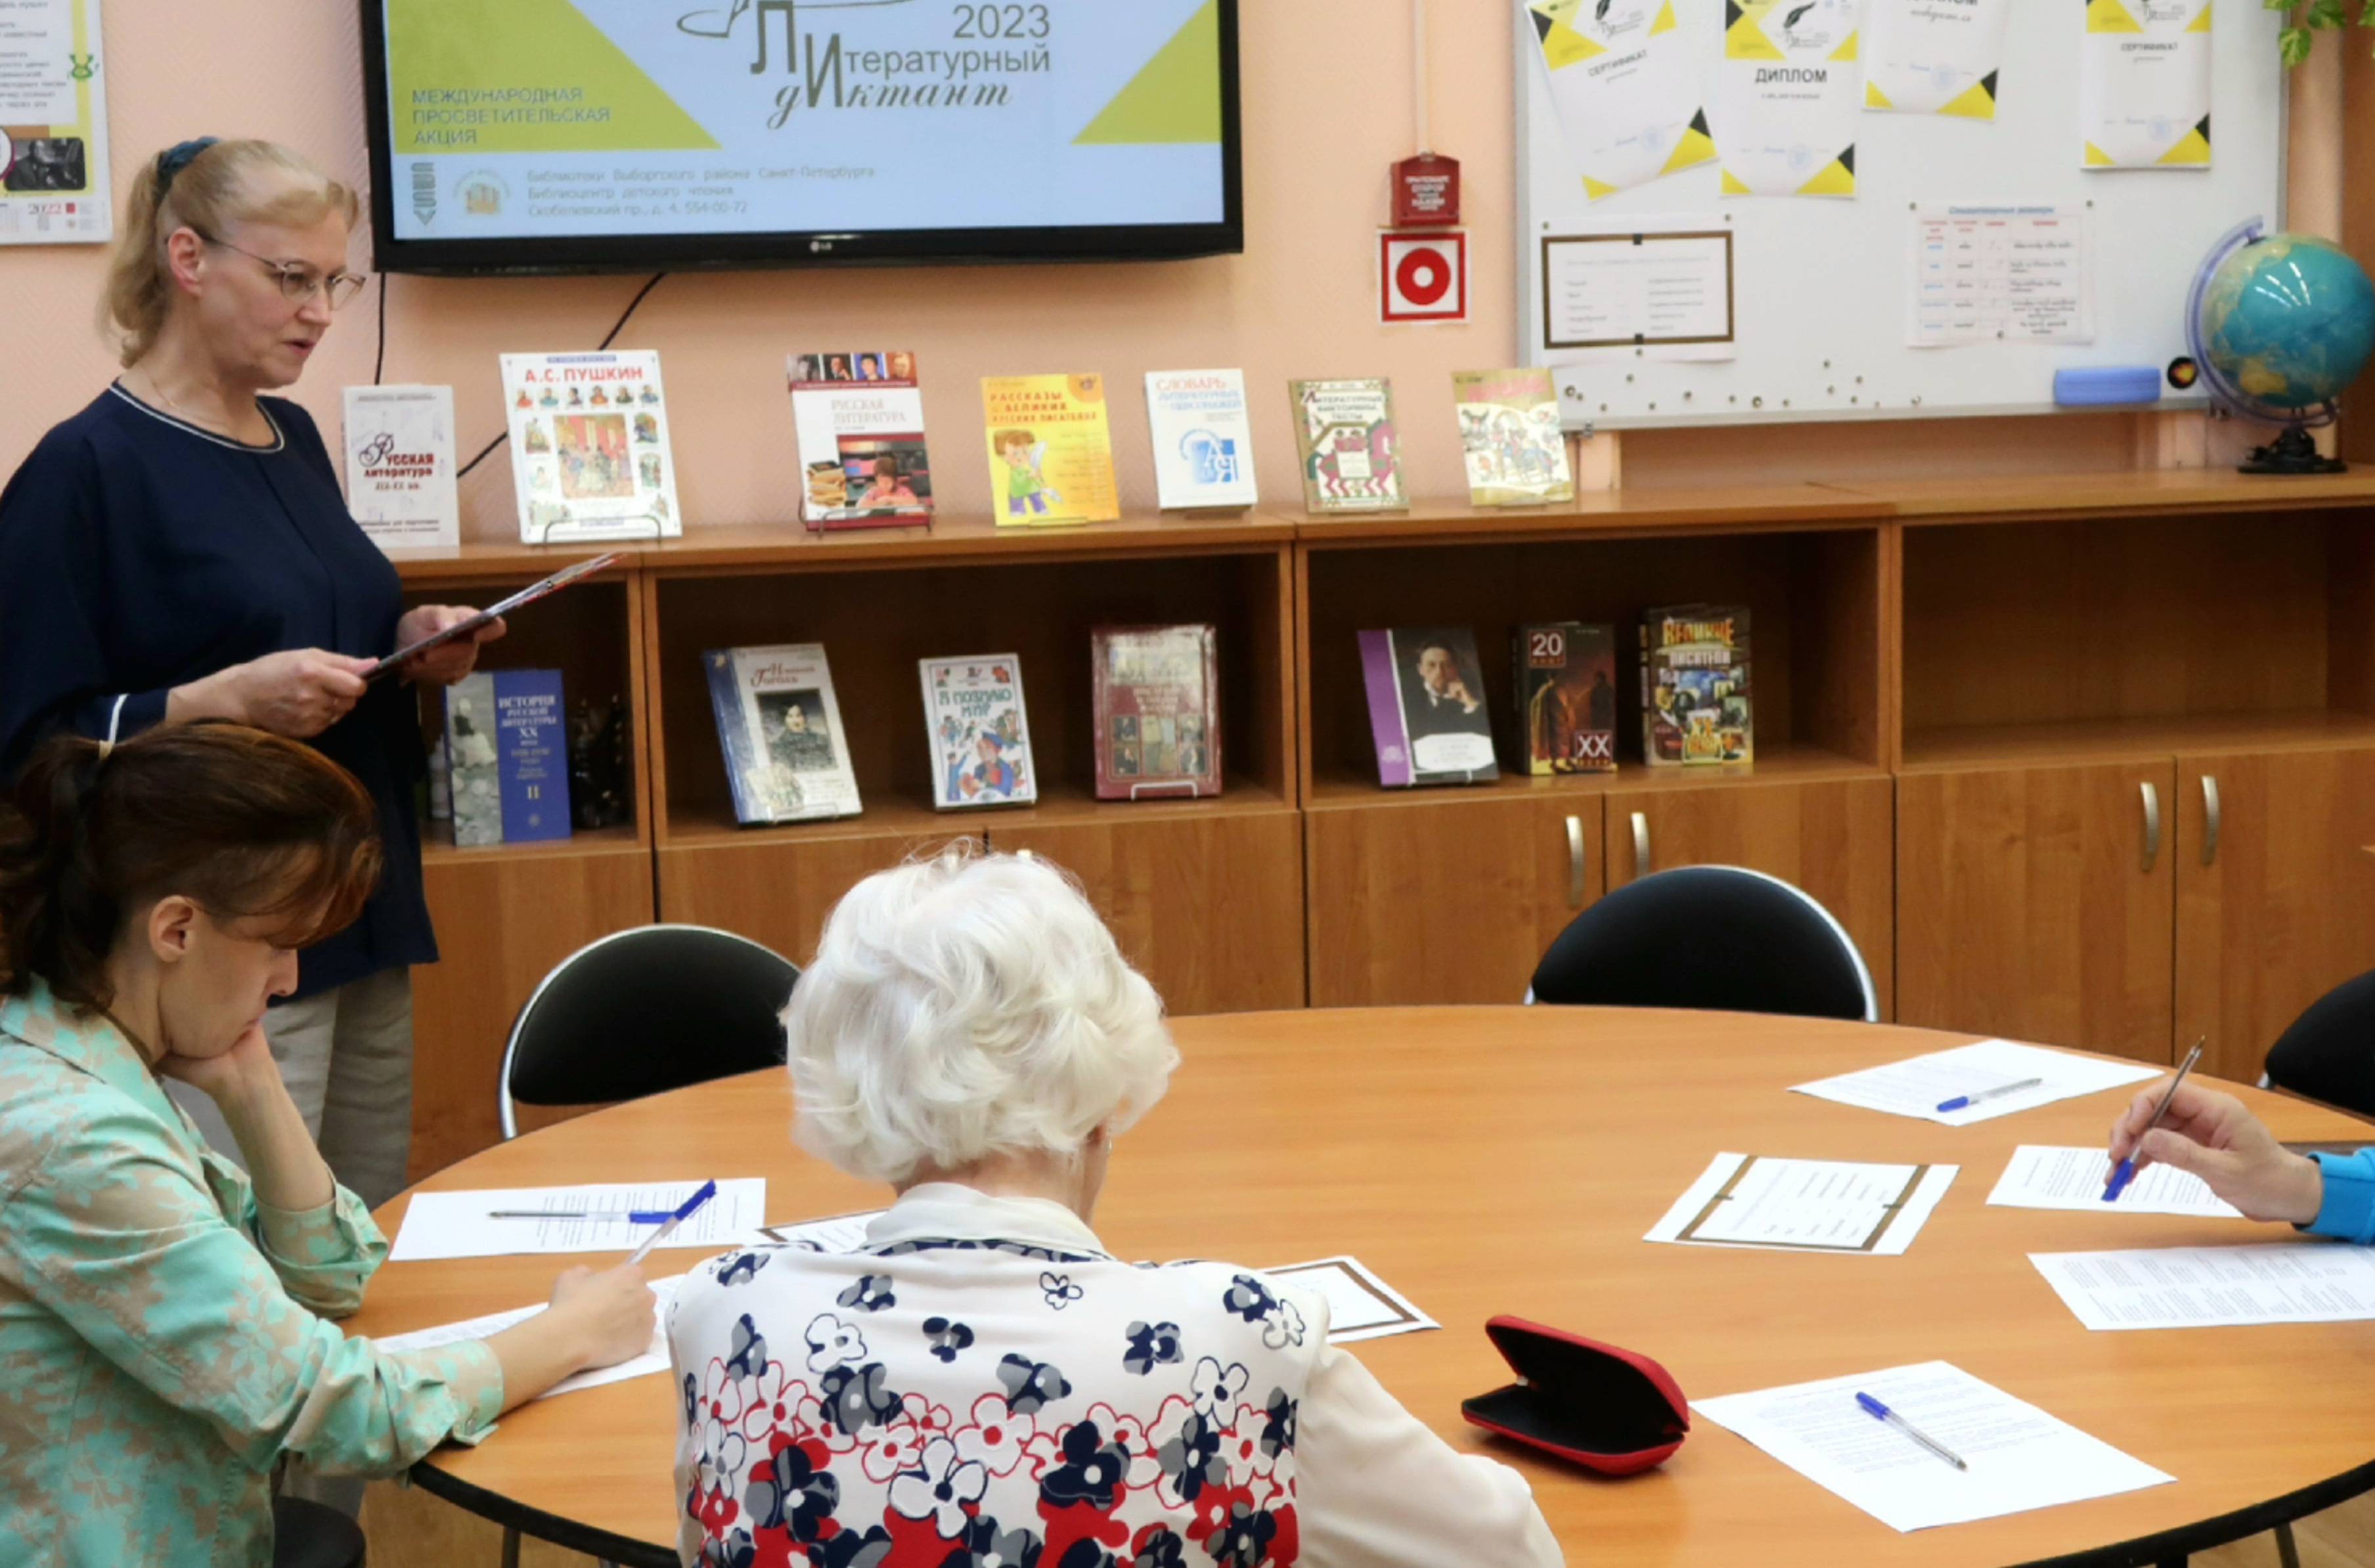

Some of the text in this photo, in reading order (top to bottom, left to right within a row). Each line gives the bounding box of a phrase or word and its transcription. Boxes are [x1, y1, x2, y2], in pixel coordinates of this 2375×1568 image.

[953, 5, 1050, 39] 2023
[2120, 42, 2178, 51] СЕРТИФИКАТ
[1587, 49, 1648, 77] СЕРТИФИКАТ
[1755, 68, 1827, 83] ДИПЛОМ
[412, 88, 583, 105] МЕЖДУНАРОДНАЯ
[413, 108, 611, 125] ПРОСВЕТИТЕЛЬСКАЯ
[414, 131, 477, 146] АКЦИЯ
[527, 169, 605, 182] Библиотеки
[614, 168, 695, 184] Выборгского
[703, 168, 750, 183] района
[528, 185, 734, 202] Библиоцентр детского чтения
[528, 204, 621, 217] Скобелевский
[564, 366, 643, 382] ПУШКИН
[1156, 377, 1227, 391] СЛОВАРЬ
[832, 399, 885, 411] РУССКАЯ
[990, 392, 1062, 402] РАССКАЗЫ
[833, 411, 907, 425] ЛИТЕРАТУРА
[1662, 618, 1735, 646] ВЕЛИКИЕ
[1531, 632, 1563, 657] 20
[499, 695, 556, 709] ИСТОРИЯ
[1578, 734, 1611, 758] XX
